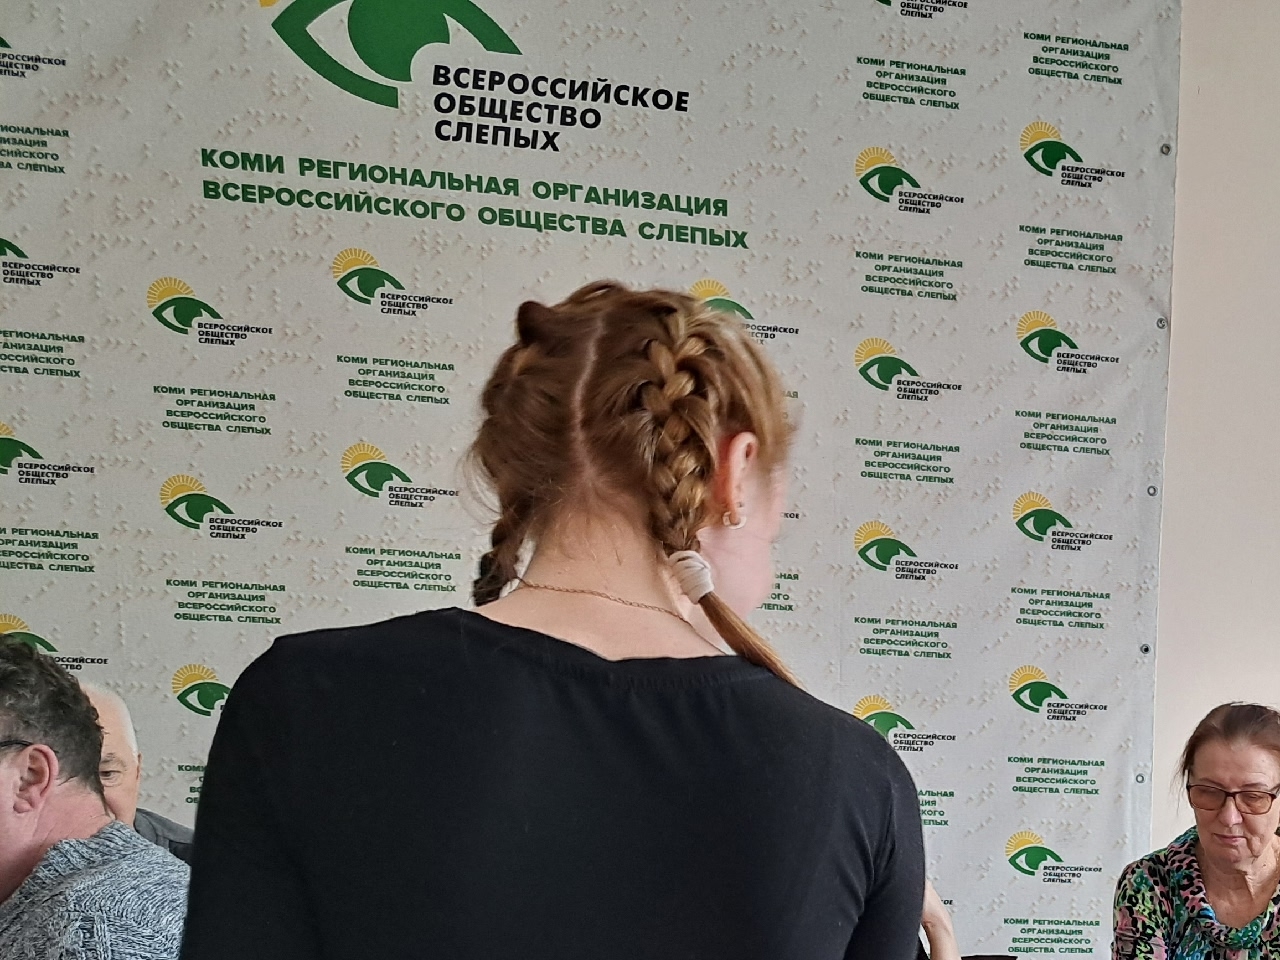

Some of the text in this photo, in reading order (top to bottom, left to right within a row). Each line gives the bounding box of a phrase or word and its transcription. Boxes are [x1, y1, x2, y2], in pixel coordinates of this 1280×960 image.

[900, 2, 944, 13] ОБЩЕСТВО
[900, 9, 933, 19] СЛЕПЫХ
[1024, 32, 1129, 51] КОМИ РЕГИОНАЛЬНАЯ
[1042, 46, 1110, 60] ОРГАНИЗАЦИЯ
[857, 56, 966, 76] КОМИ РЕГИОНАЛЬНАЯ
[1033, 56, 1119, 73] ВСЕРОССИЙСКОГО
[876, 70, 946, 85] ОРГАНИЗАЦИЯ
[1028, 68, 1122, 85] ОБЩЕСТВА СЛЕПЫХ
[433, 65, 690, 112] ВСЕРОССИЙСКОЕ
[866, 81, 956, 97] ВСЕРОССИЙСКОГО
[863, 92, 959, 110] ОБЩЕСТВА СЛЕПЫХ
[434, 92, 602, 129] ОБЩЕСТВО
[0, 125, 69, 138] ИОНАЛЬНАЯ
[434, 120, 560, 152] СЛЕПЫХ
[0, 149, 59, 161] СИЙСКОГО
[17, 163, 65, 174] СЛЕПЫХ
[1061, 165, 1125, 177] ВСЕРОССИЙСКОЕ
[201, 148, 728, 217] КОМИ РЕГИОНАЛЬНАЯ ОРГАНИЗАЦИЯ
[1061, 172, 1103, 182] ОБЩЕСТВО
[1061, 179, 1092, 188] СЛЕПЫХ
[899, 191, 964, 203] ВСЕРОССИЙСКОЕ
[899, 198, 941, 208] ОБЩЕСТВО
[203, 180, 749, 249] ВСЕРОССИЙСКОГО ОБЩЕСТВА СЛЕПЫХ
[898, 205, 930, 214] СЛЕПЫХ
[1019, 225, 1123, 243] КОМИ РЕГИОНАЛЬНАЯ
[1037, 238, 1104, 251] ОРГАНИЗАЦИЯ
[856, 251, 963, 268] КОМИ РЕГИОНАЛЬНАЯ
[1028, 248, 1113, 262] ВСЕРОССИЙСКОГО
[2, 262, 80, 273] ВСЕРОССИЙСКОЕ
[874, 264, 944, 277] ОРГАНИЗАЦИЯ
[1024, 259, 1116, 274] ОБЩЕСТВА СЛЕПЫХ
[3, 269, 53, 279] ОБЩЕСТВО
[3, 275, 41, 286] СЛЕПЫХ
[865, 275, 953, 289] ВСЕРОССИЙСКОГО
[381, 293, 453, 304] ВСЕРОССИЙСКОЕ
[861, 286, 957, 301] ОБЩЕСТВА СЛЕПЫХ
[381, 300, 428, 309] ОБЩЕСТВО
[381, 308, 416, 316] СЛЕПЫХ
[198, 323, 272, 334] ВСЕРОССИЙСКОЕ
[198, 330, 247, 339] ОБЩЕСТВО
[198, 337, 235, 346] СЛЕПЫХ
[0, 353, 75, 365] ОССИЙСКОГО
[337, 355, 454, 371] КОМИ РЕГИОНАЛЬНАЯ
[1057, 352, 1119, 363] ВСЕРОССИЙСКОЕ
[1057, 357, 1097, 368] ОБЩЕСТВО
[34, 368, 80, 378] СЛЕПЫХ
[358, 369, 435, 381] ОРГАНИЗАЦИЯ
[1056, 366, 1087, 374] СЛЕПЫХ
[349, 379, 445, 393] ВСЕРОССИЙСКОГО
[897, 380, 962, 390] ВСЕРОССИЙСКОЕ
[897, 386, 939, 395] ОБЩЕСТВО
[153, 386, 276, 401] КОМИ РЕГИОНАЛЬНАЯ
[344, 390, 450, 404] ОБЩЕСТВА СЛЕПЫХ
[176, 399, 255, 411] ОРГАНИЗАЦИЯ
[166, 410, 266, 423] ВСЕРОССИЙСКОГО
[1015, 410, 1116, 424] КОМИ РЕГИОНАЛЬНАЯ
[162, 421, 271, 435] ОБЩЕСТВА СЛЕПЫХ
[1033, 422, 1098, 433] ОРГАНИЗАЦИЯ
[1024, 432, 1107, 444] ВСЕРОССИЙСКОГО
[855, 438, 960, 452] КОМИ РЕГИОНАЛЬНАЯ
[1020, 442, 1110, 455] ОБЩЕСТВА СЛЕПЫХ
[874, 451, 942, 462] ОРГАНИЗАЦИЯ
[18, 463, 94, 473] ВСЕРОССИЙСКОЕ
[865, 461, 951, 473] ВСЕРОССИЙСКОГО
[18, 470, 68, 478] ОБЩЕСТВО
[861, 471, 954, 485] ОБЩЕСТВА СЛЕПЫХ
[19, 477, 56, 485] СЛЕПЫХ
[389, 491, 435, 501] ОБЩЕСТВО
[389, 498, 424, 508] СЛЕПЫХ
[209, 518, 283, 527] ВСЕРОССИЙСКОЕ
[11, 528, 99, 539] РЕГИОНАЛЬНАЯ
[209, 525, 257, 533] ОБЩЕСТВО
[210, 531, 246, 539] СЛЕПЫХ
[1052, 531, 1113, 540] ВСЕРОССИЙСКОЕ
[1052, 537, 1091, 545] ОБЩЕСТВО
[345, 547, 461, 560] КОМИ РЕГИОНАЛЬНАЯ
[0, 559, 95, 572] ЩЕСТВА СЛЕПЫХ
[366, 559, 441, 569] ОРГАНИЗАЦИЯ
[895, 560, 958, 569] ВСЕРОССИЙСКОЕ
[357, 569, 451, 581] ВСЕРОССИЙСКОГО
[166, 579, 285, 591] КОМИ РЕГИОНАЛЬНАЯ
[353, 580, 456, 592] ОБЩЕСТВА СЛЕПЫХ
[188, 591, 265, 602] ОРГАНИЗАЦИЯ
[1011, 587, 1110, 599] КОМИ РЕГИОНАЛЬНАЯ
[178, 602, 276, 613] ВСЕРОССИЙСКОГО
[760, 602, 794, 611] ЛЕПЫХ
[1029, 598, 1093, 608] ОРГАНИЗАЦИЯ
[174, 613, 281, 624] ОБЩЕСТВА СЛЕПЫХ
[1020, 608, 1101, 618] ВСЕРОССИЙСКОГО
[886, 619, 957, 628] РЕГИОНАЛЬНАЯ
[1016, 618, 1104, 629] ОБЩЕСТВА СЛЕПЫХ
[873, 628, 939, 638] ОРГАНИЗАЦИЯ
[864, 638, 948, 648] ВСЕРОССИЙСКОГО
[860, 648, 951, 659] ОБЩЕСТВА СЛЕПЫХ
[1037, 758, 1105, 766] РЕГИОНАЛЬНАЯ
[1024, 767, 1088, 776] ОРГАНИЗАЦИЯ
[1016, 776, 1096, 785] ВСЕРОССИЙСКОГО
[1012, 786, 1060, 795] ОБЩЕСТВА
[1012, 935, 1091, 944] ВСЕРОССИЙСКОГО
